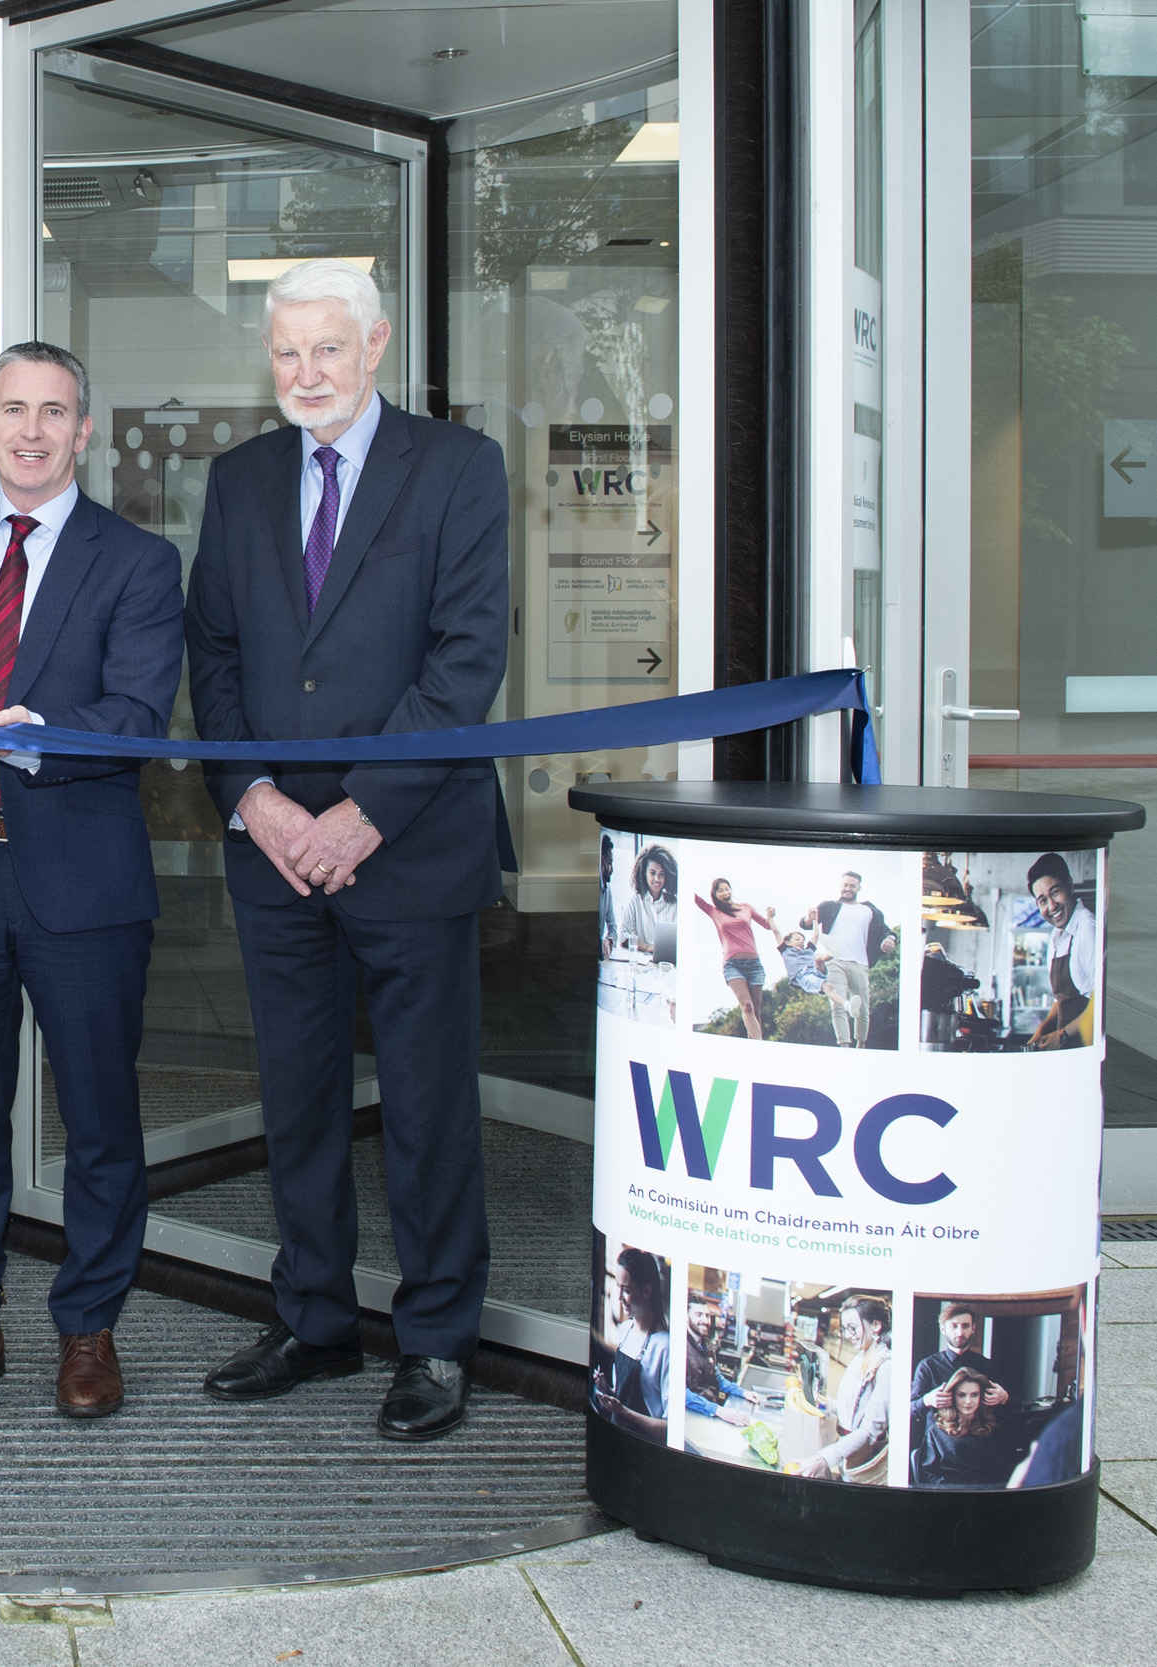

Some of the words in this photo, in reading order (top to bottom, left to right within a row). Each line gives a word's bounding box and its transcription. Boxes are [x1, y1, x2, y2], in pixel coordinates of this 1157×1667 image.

[569, 430, 611, 444] Elysian
[614, 431, 651, 442] Hoe
[572, 469, 648, 496] WRC
[629, 1060, 959, 1205] WRC
[628, 1183, 645, 1199] An
[647, 1188, 719, 1217] Coimisiún
[724, 1207, 749, 1221] um
[754, 1210, 859, 1234] Chaidreamh
[865, 1223, 895, 1237] san
[901, 1220, 926, 1239] Áit
[932, 1223, 980, 1240] Oibre
[628, 1202, 700, 1233] Workplace
[704, 1222, 781, 1247] Relations
[786, 1235, 892, 1258] Commission
